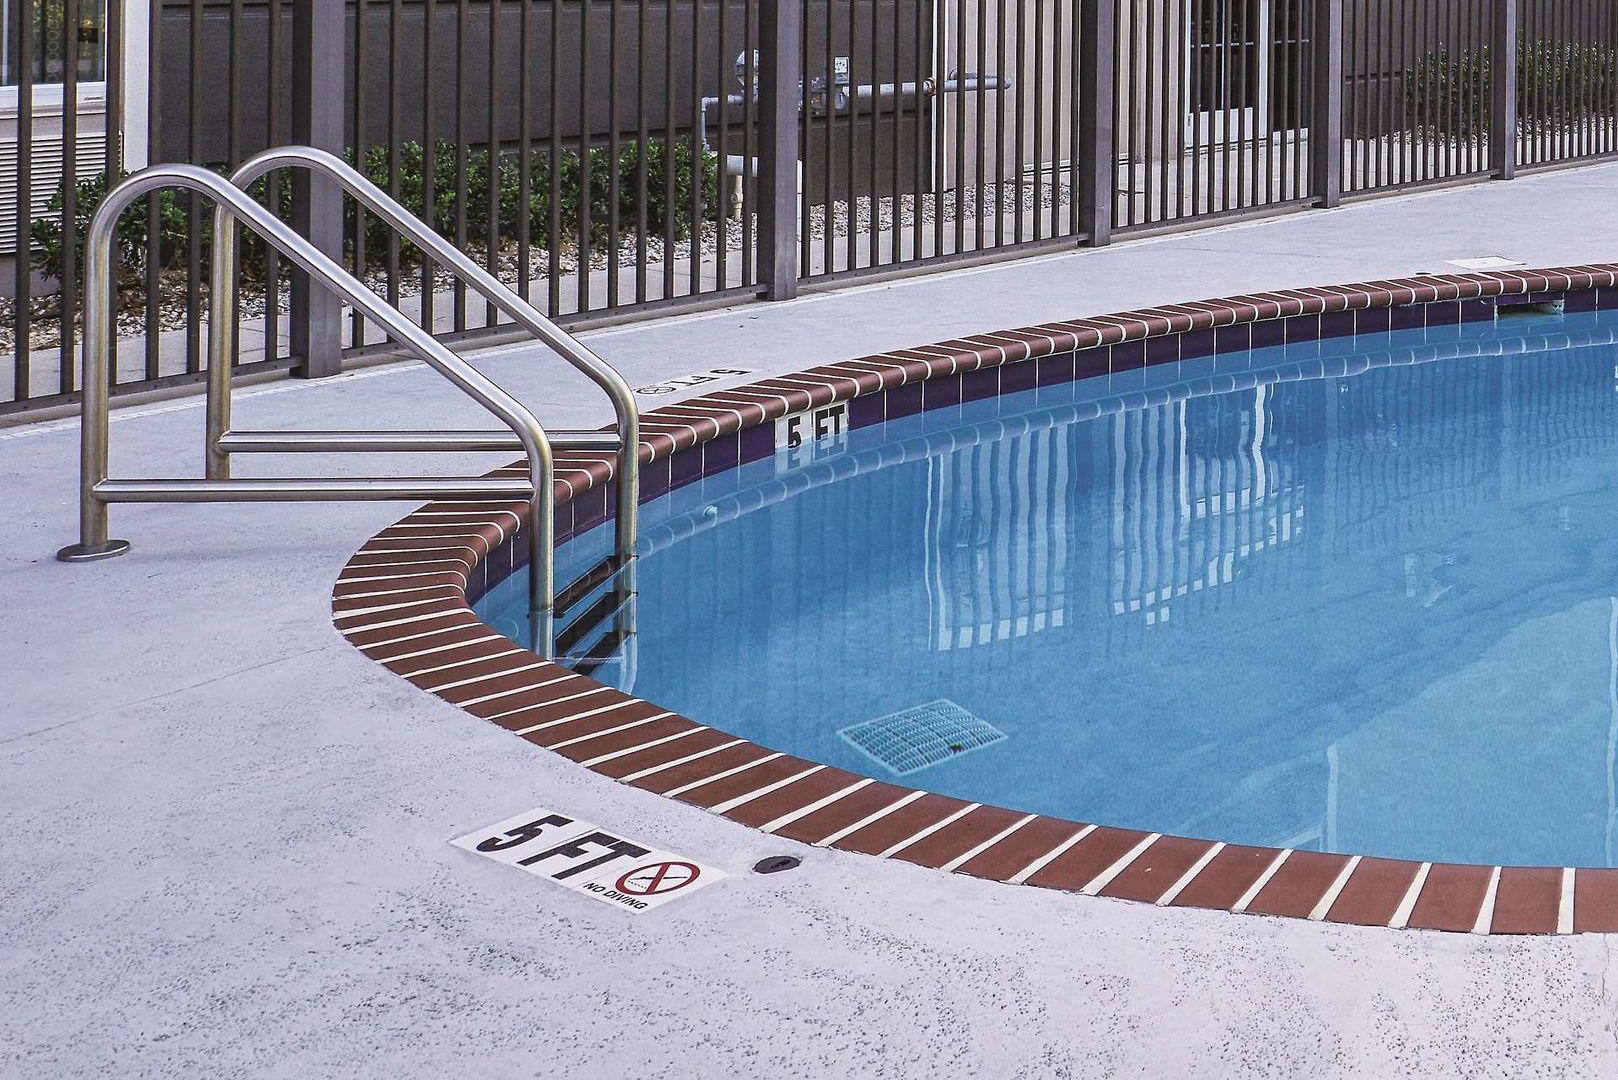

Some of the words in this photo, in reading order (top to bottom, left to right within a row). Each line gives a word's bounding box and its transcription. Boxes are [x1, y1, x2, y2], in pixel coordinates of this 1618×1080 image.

[787, 415, 802, 448] 5
[476, 814, 574, 852] 5
[516, 831, 652, 879] FT
[583, 882, 607, 893] NO
[603, 890, 649, 910] DIVING
